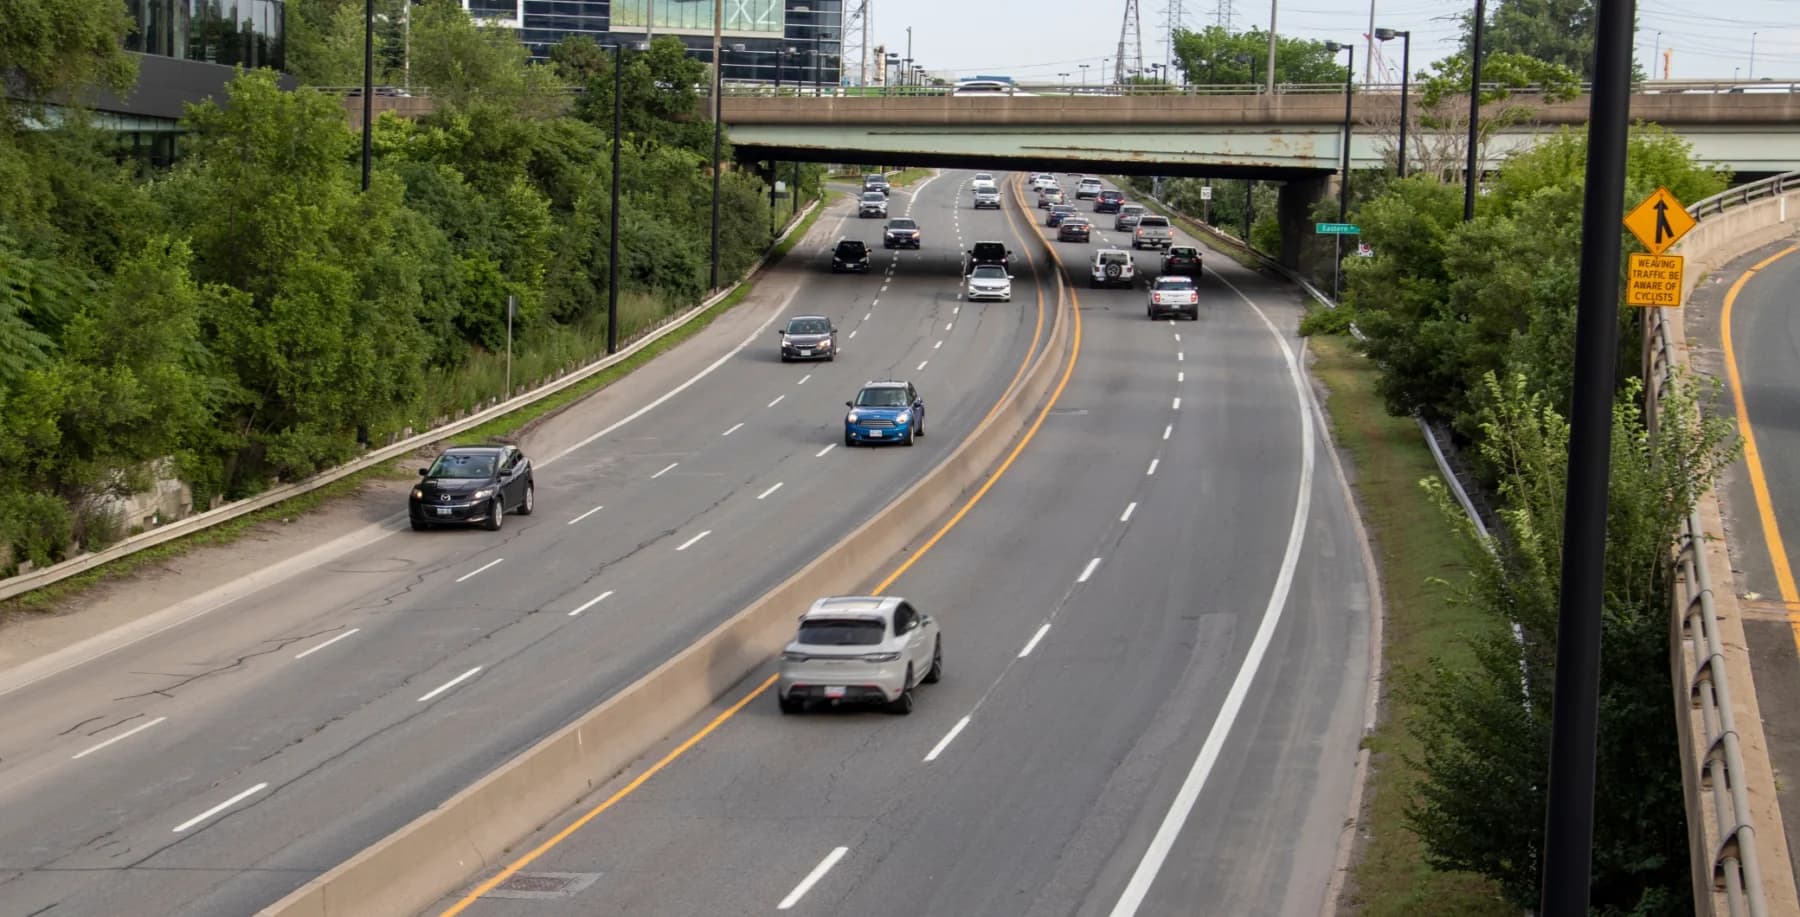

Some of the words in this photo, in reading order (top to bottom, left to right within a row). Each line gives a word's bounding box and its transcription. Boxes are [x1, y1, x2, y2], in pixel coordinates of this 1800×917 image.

[729, 0, 776, 24] X2
[1638, 259, 1675, 269] WEAVING
[1633, 269, 1666, 279] TRAFFIC
[1668, 271, 1680, 280] BE
[1633, 280, 1662, 290] AWARE
[1665, 282, 1676, 291] OF
[1634, 292, 1673, 301] CYCLISTS
